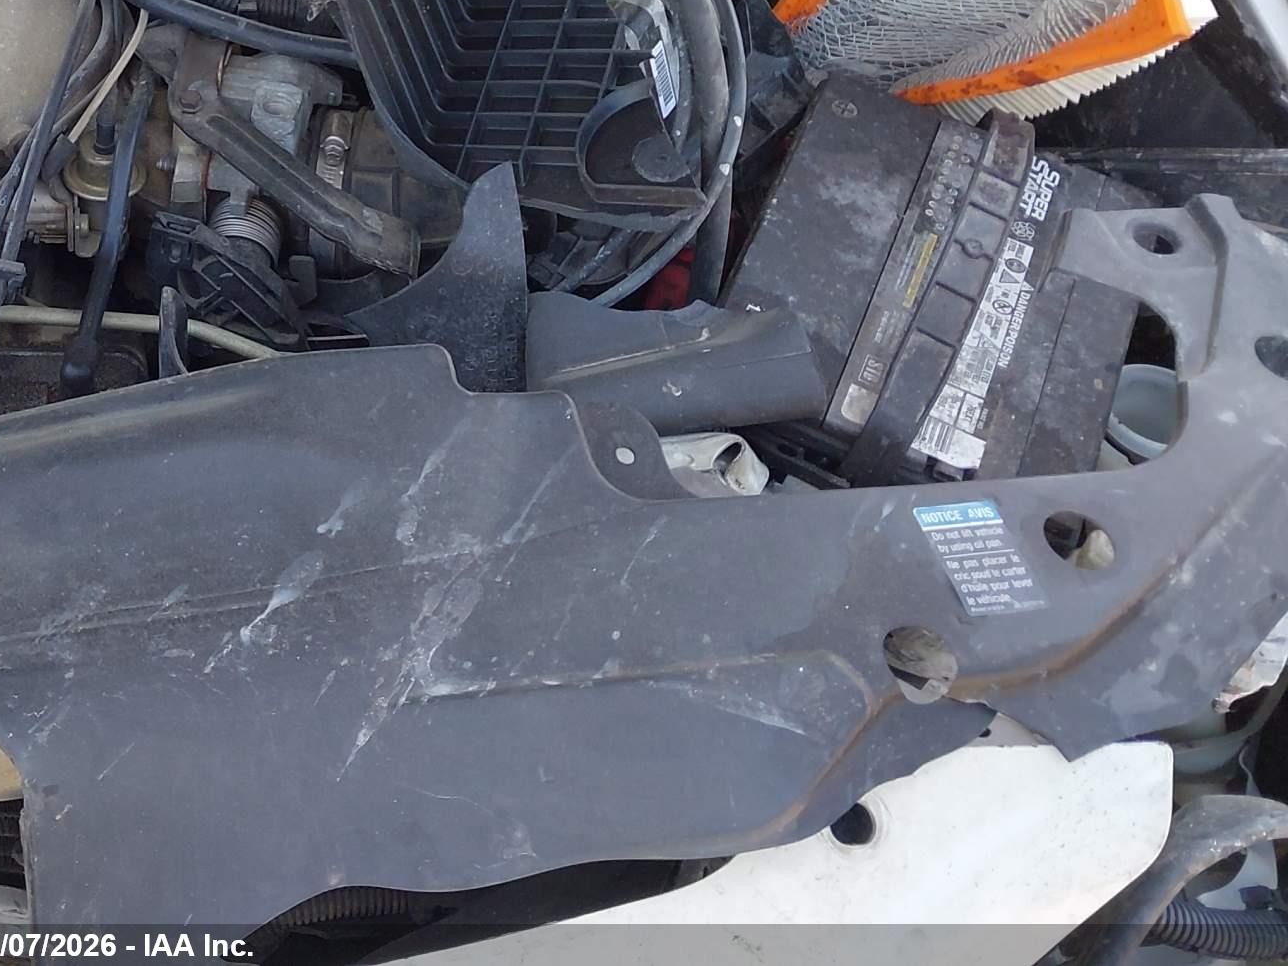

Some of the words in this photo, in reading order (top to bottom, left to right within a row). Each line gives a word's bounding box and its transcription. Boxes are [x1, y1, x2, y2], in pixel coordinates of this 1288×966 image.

[1019, 156, 1049, 218] START
[1030, 168, 1060, 222] SUPER
[920, 510, 964, 523] NOTICE
[967, 506, 994, 519] AVIS
[931, 532, 944, 541] Do
[946, 530, 960, 539] not
[961, 529, 974, 538] lift
[974, 527, 1004, 537] vehicle
[937, 544, 949, 554] by
[950, 542, 974, 553] using
[974, 540, 985, 549] oil
[985, 539, 1003, 549] pan.
[946, 560, 961, 569] Ne
[963, 559, 979, 569] pas
[982, 556, 1007, 567] placer
[1010, 554, 1020, 563] le
[954, 572, 971, 581] cric
[992, 569, 1001, 577] le
[1001, 566, 1026, 577] carter
[961, 583, 989, 593] d'huile
[990, 581, 1010, 592] pour
[1011, 578, 1033, 588] lever
[966, 596, 976, 606] le
